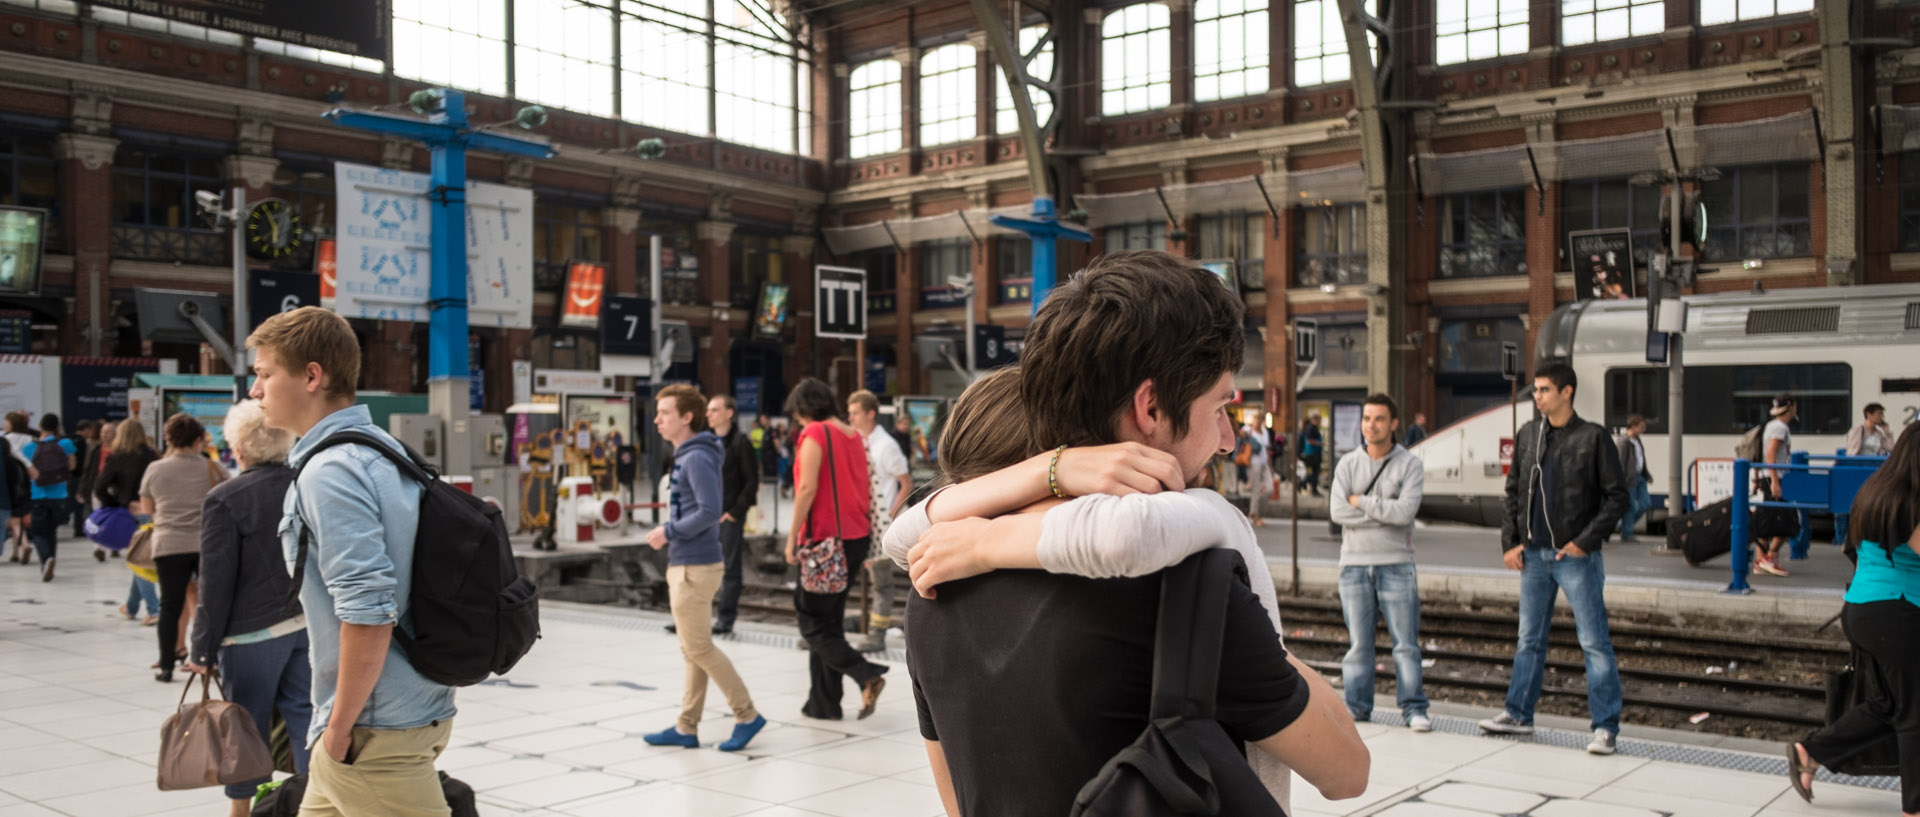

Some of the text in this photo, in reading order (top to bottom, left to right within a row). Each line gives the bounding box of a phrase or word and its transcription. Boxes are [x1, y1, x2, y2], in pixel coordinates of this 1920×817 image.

[280, 294, 301, 313] 6
[820, 279, 862, 325] TT
[623, 315, 638, 341] 7
[986, 337, 998, 359] 8
